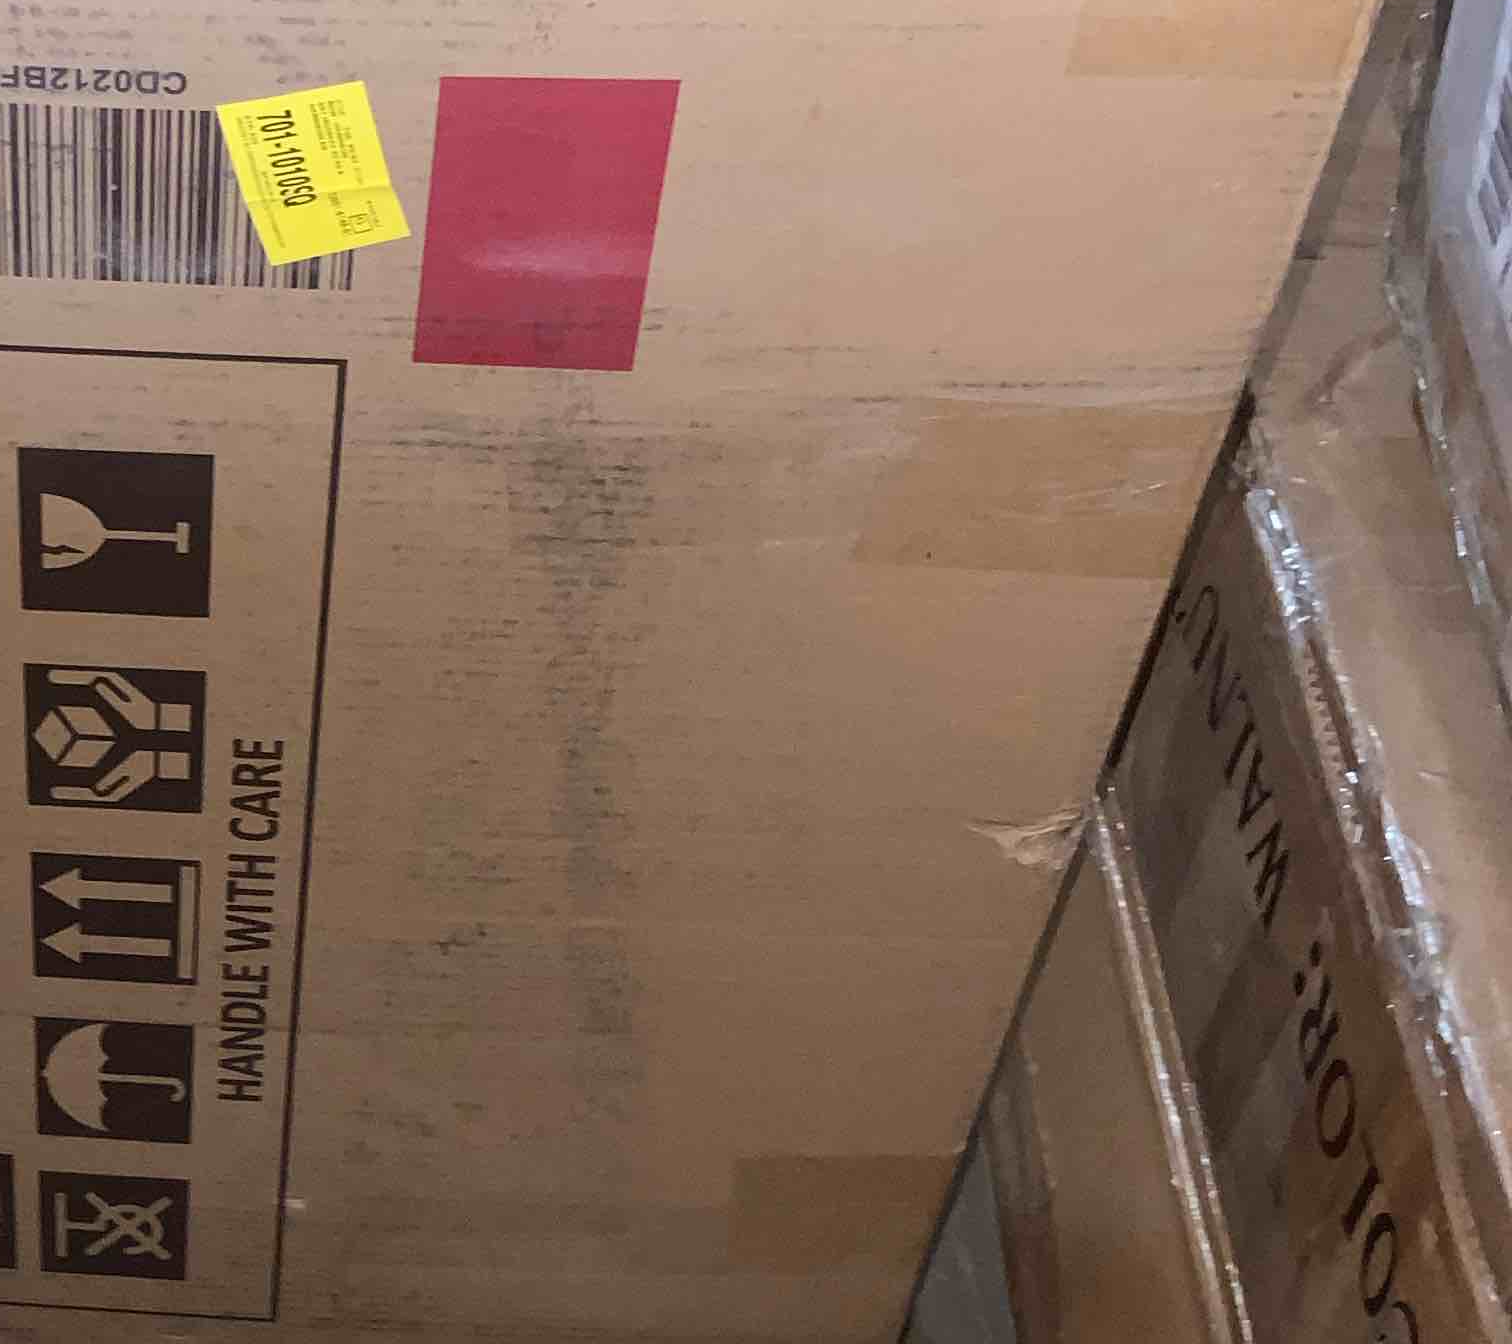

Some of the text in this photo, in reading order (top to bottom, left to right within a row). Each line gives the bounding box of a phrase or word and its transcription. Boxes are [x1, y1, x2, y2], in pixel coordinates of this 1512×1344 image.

[218, 737, 285, 1105] HANDLE WITH CARE
[1175, 584, 1288, 928] WALNU
